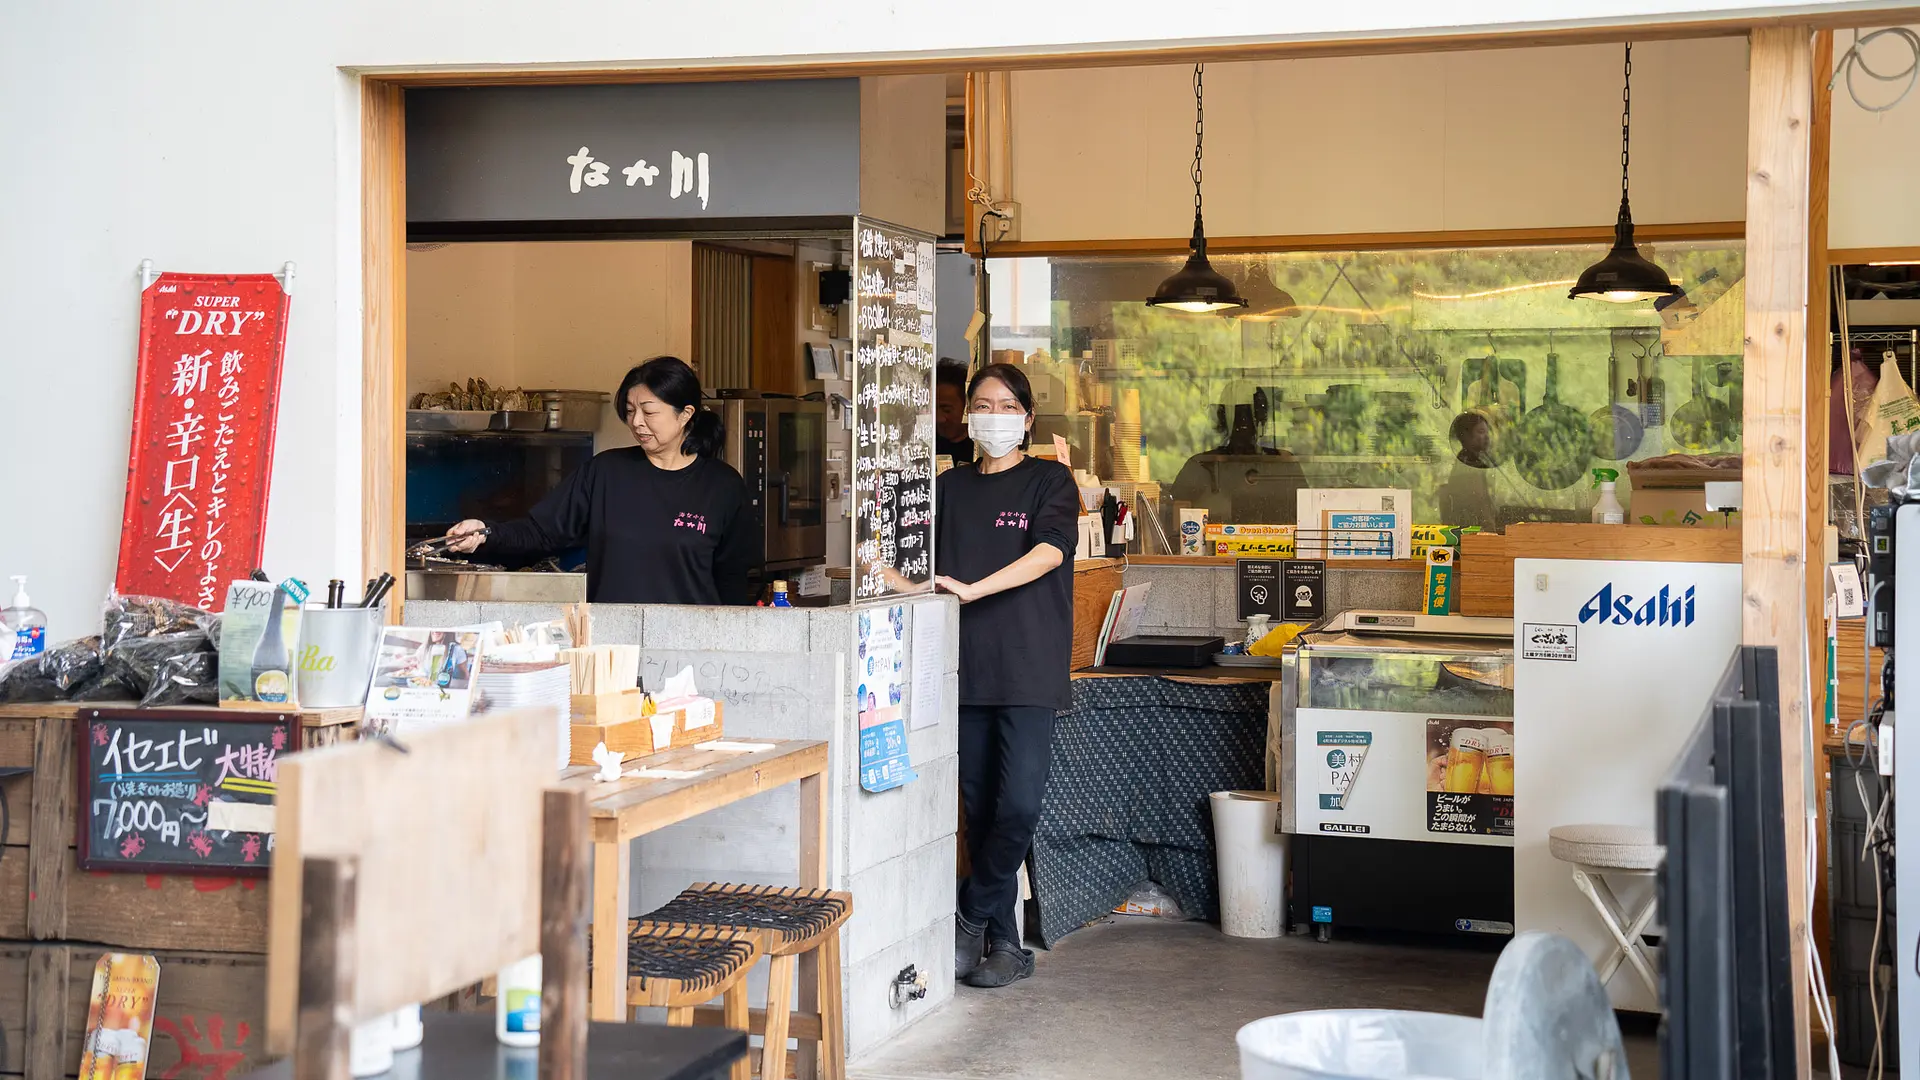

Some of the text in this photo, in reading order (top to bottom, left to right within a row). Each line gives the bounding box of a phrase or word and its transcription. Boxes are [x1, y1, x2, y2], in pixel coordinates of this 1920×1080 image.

[194, 295, 241, 307] SUPER
[196, 350, 245, 611] 飲みごたえとキレのよさ
[1240, 526, 1262, 534] Oven
[1433, 572, 1447, 608] 宅急便
[232, 587, 271, 610] ¥900
[1578, 581, 1696, 628] Asahi
[102, 727, 219, 780] イセエビ
[1436, 793, 1472, 804] ビールが
[1435, 803, 1463, 813] うまい。
[1432, 812, 1477, 823] この瞬間が
[1323, 824, 1366, 834] GALILEI
[1431, 821, 1477, 833] たまらない。
